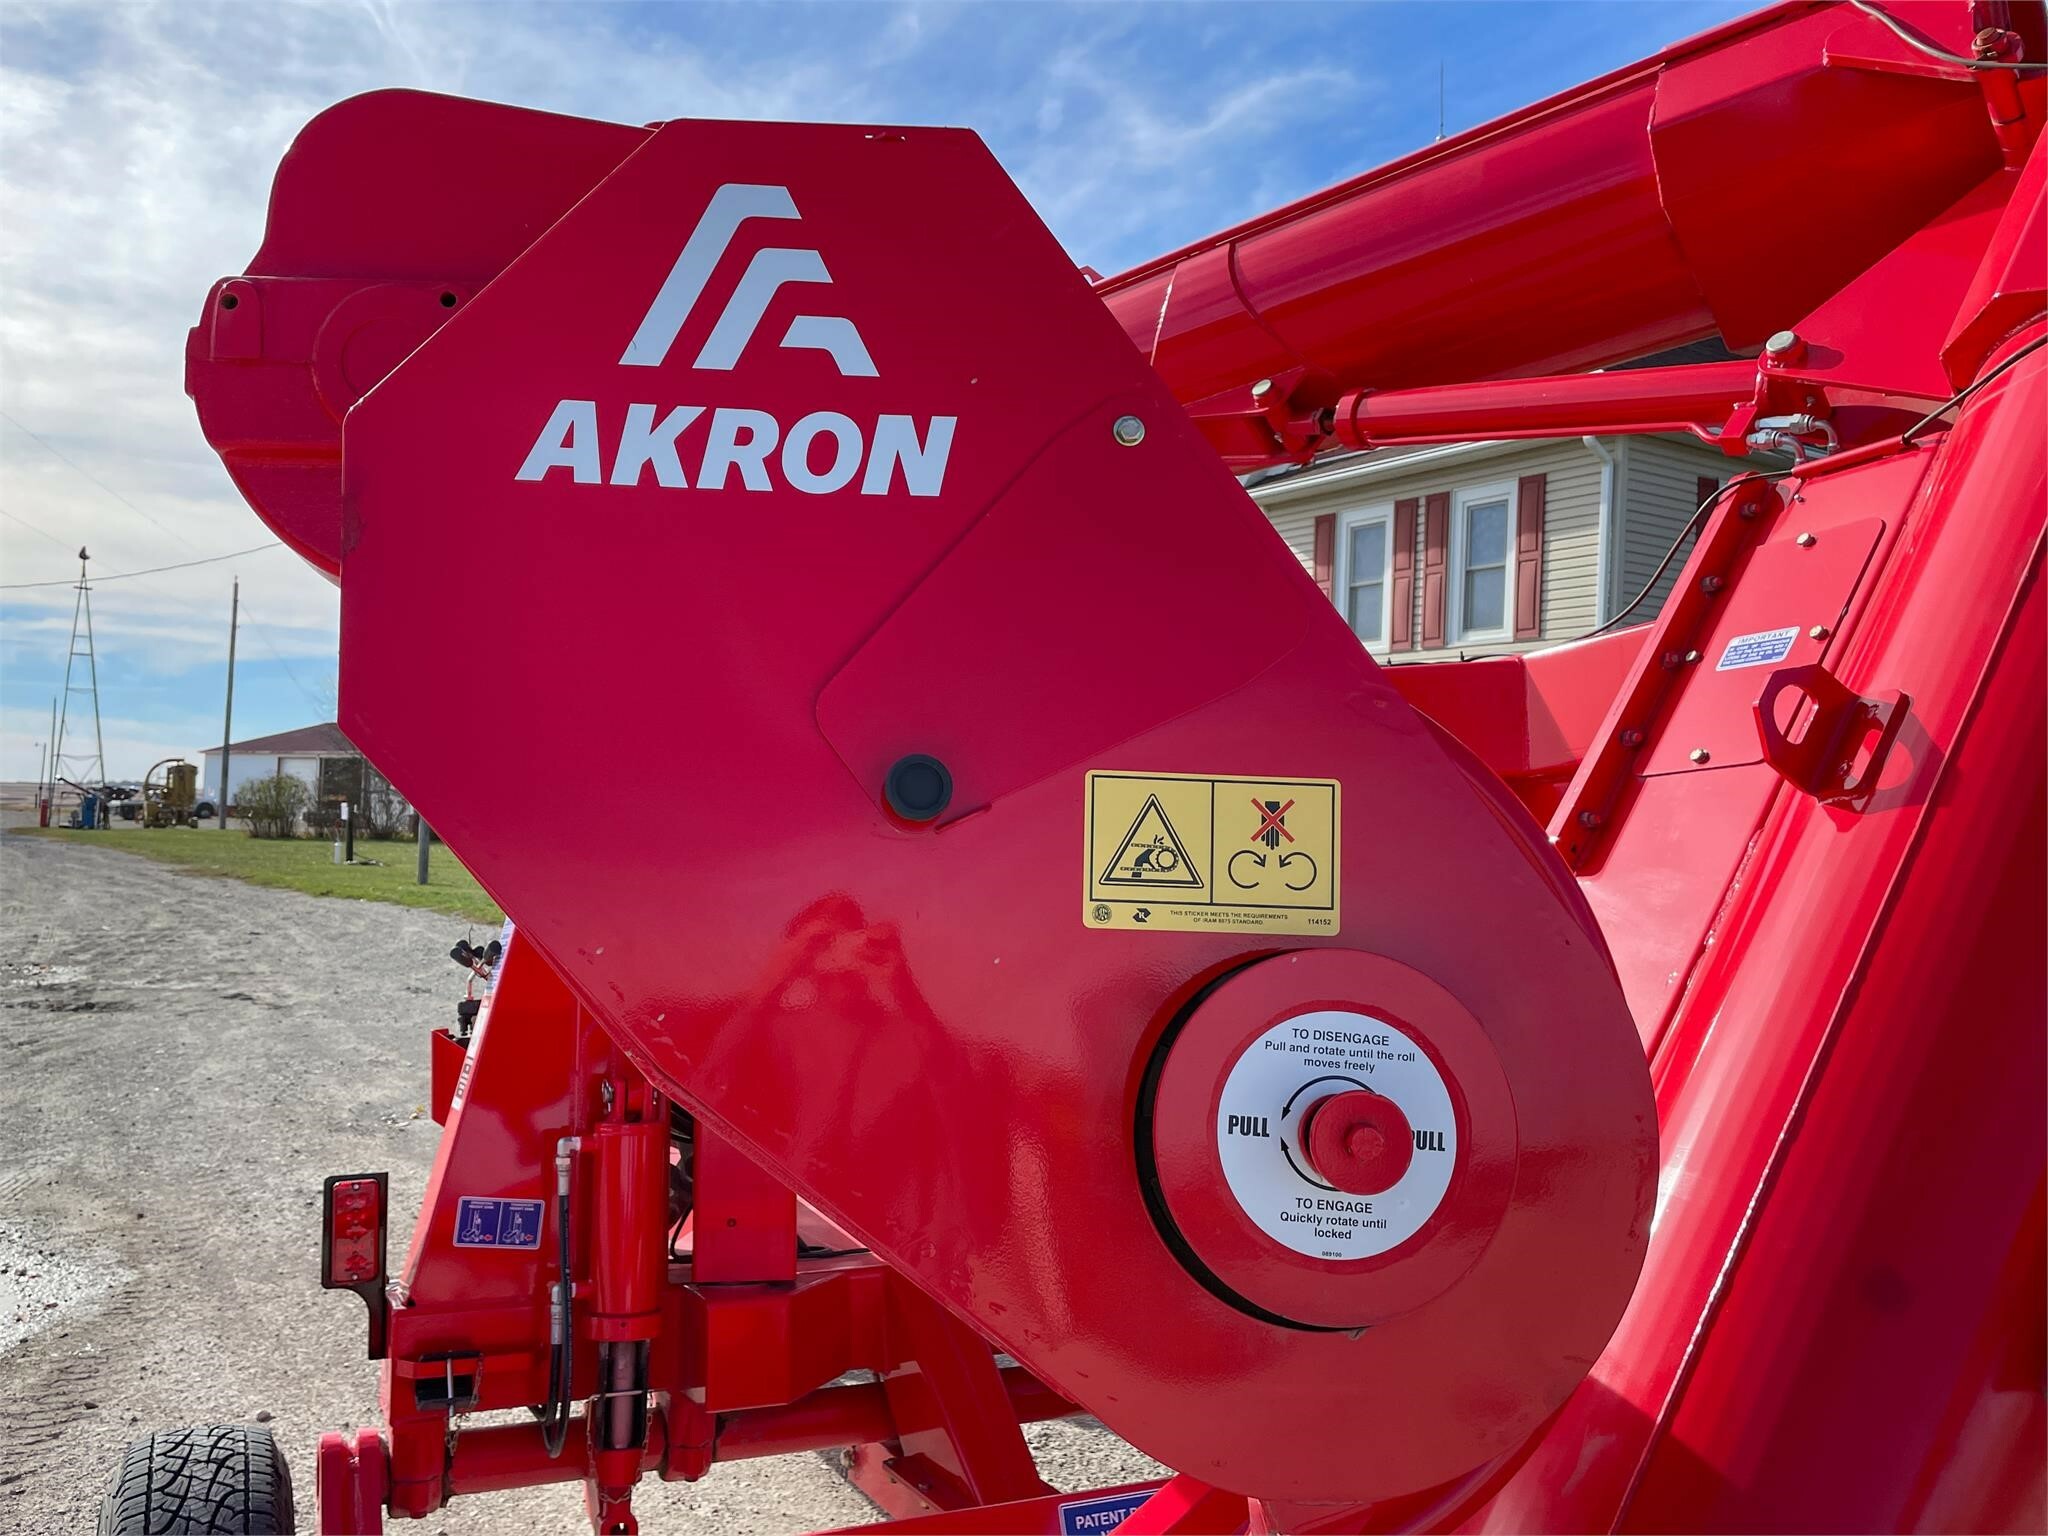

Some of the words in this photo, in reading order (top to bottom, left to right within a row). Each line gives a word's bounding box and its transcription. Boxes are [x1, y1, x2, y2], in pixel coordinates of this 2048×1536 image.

[514, 399, 958, 497] AKRON
[1738, 632, 1789, 644] IMPORTANT
[1308, 918, 1332, 926] 114152
[1292, 1028, 1309, 1040] TO
[1313, 1030, 1390, 1047] DISENGAGE
[1265, 1040, 1286, 1051] Pull
[1289, 1043, 1310, 1053] and
[1313, 1046, 1346, 1057] rotate
[1349, 1049, 1374, 1059] until
[1377, 1050, 1395, 1061] the
[1397, 1053, 1416, 1063] roll
[1304, 1058, 1341, 1069] moves
[1344, 1060, 1376, 1074] freely
[1228, 1115, 1270, 1138] PULL
[1295, 1197, 1314, 1210] TO
[1317, 1199, 1373, 1214] ENGAGE
[1280, 1211, 1322, 1227] Quickly
[1325, 1216, 1359, 1227] rotate
[1362, 1218, 1388, 1229] until
[1314, 1227, 1352, 1240] locked
[1075, 1509, 1126, 1529] PATENT
